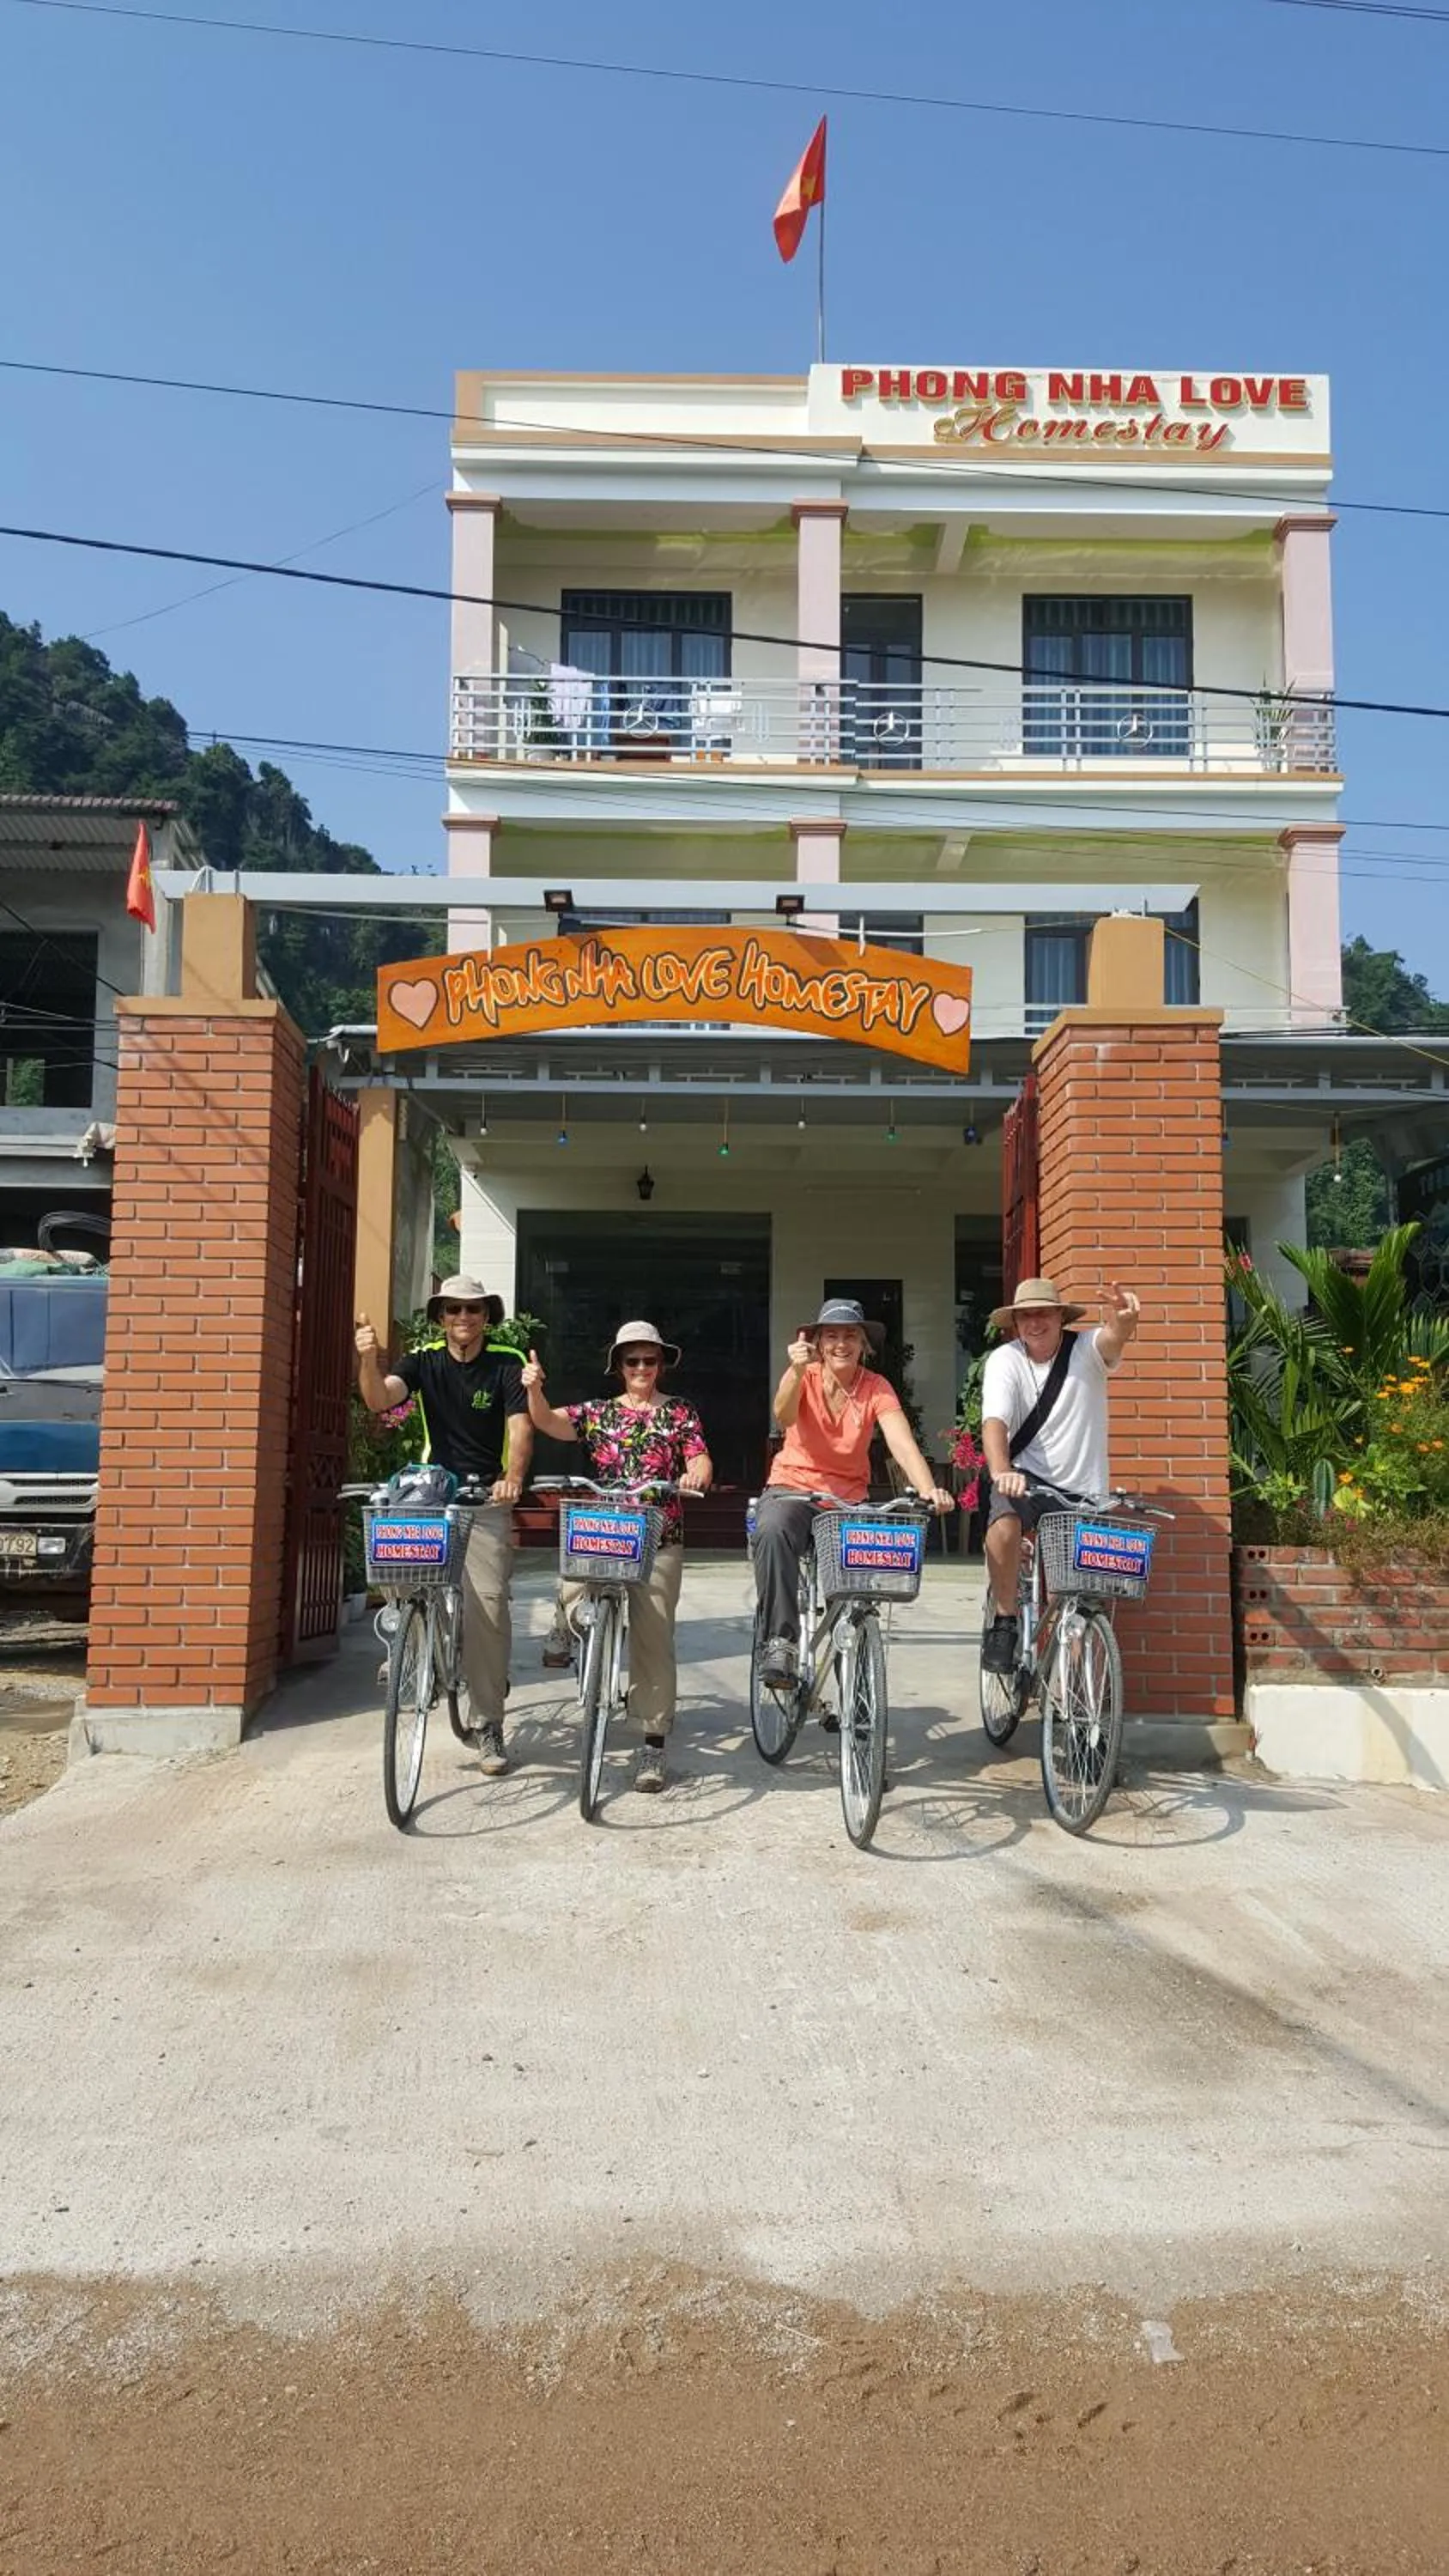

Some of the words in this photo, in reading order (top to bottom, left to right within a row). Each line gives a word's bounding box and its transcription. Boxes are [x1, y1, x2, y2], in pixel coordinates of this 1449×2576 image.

[840, 369, 1027, 403] PHONG
[1048, 372, 1160, 406] NHA
[1179, 375, 1308, 410] LOVE
[933, 404, 1229, 451] Homestay
[443, 948, 567, 1027] PHONG
[563, 939, 638, 1007] NHA
[641, 947, 735, 1005] LOVE
[737, 938, 931, 1035] HOMESTAY
[375, 1543, 440, 1560] HOMESTAY
[847, 1548, 912, 1567] HOMESTAY
